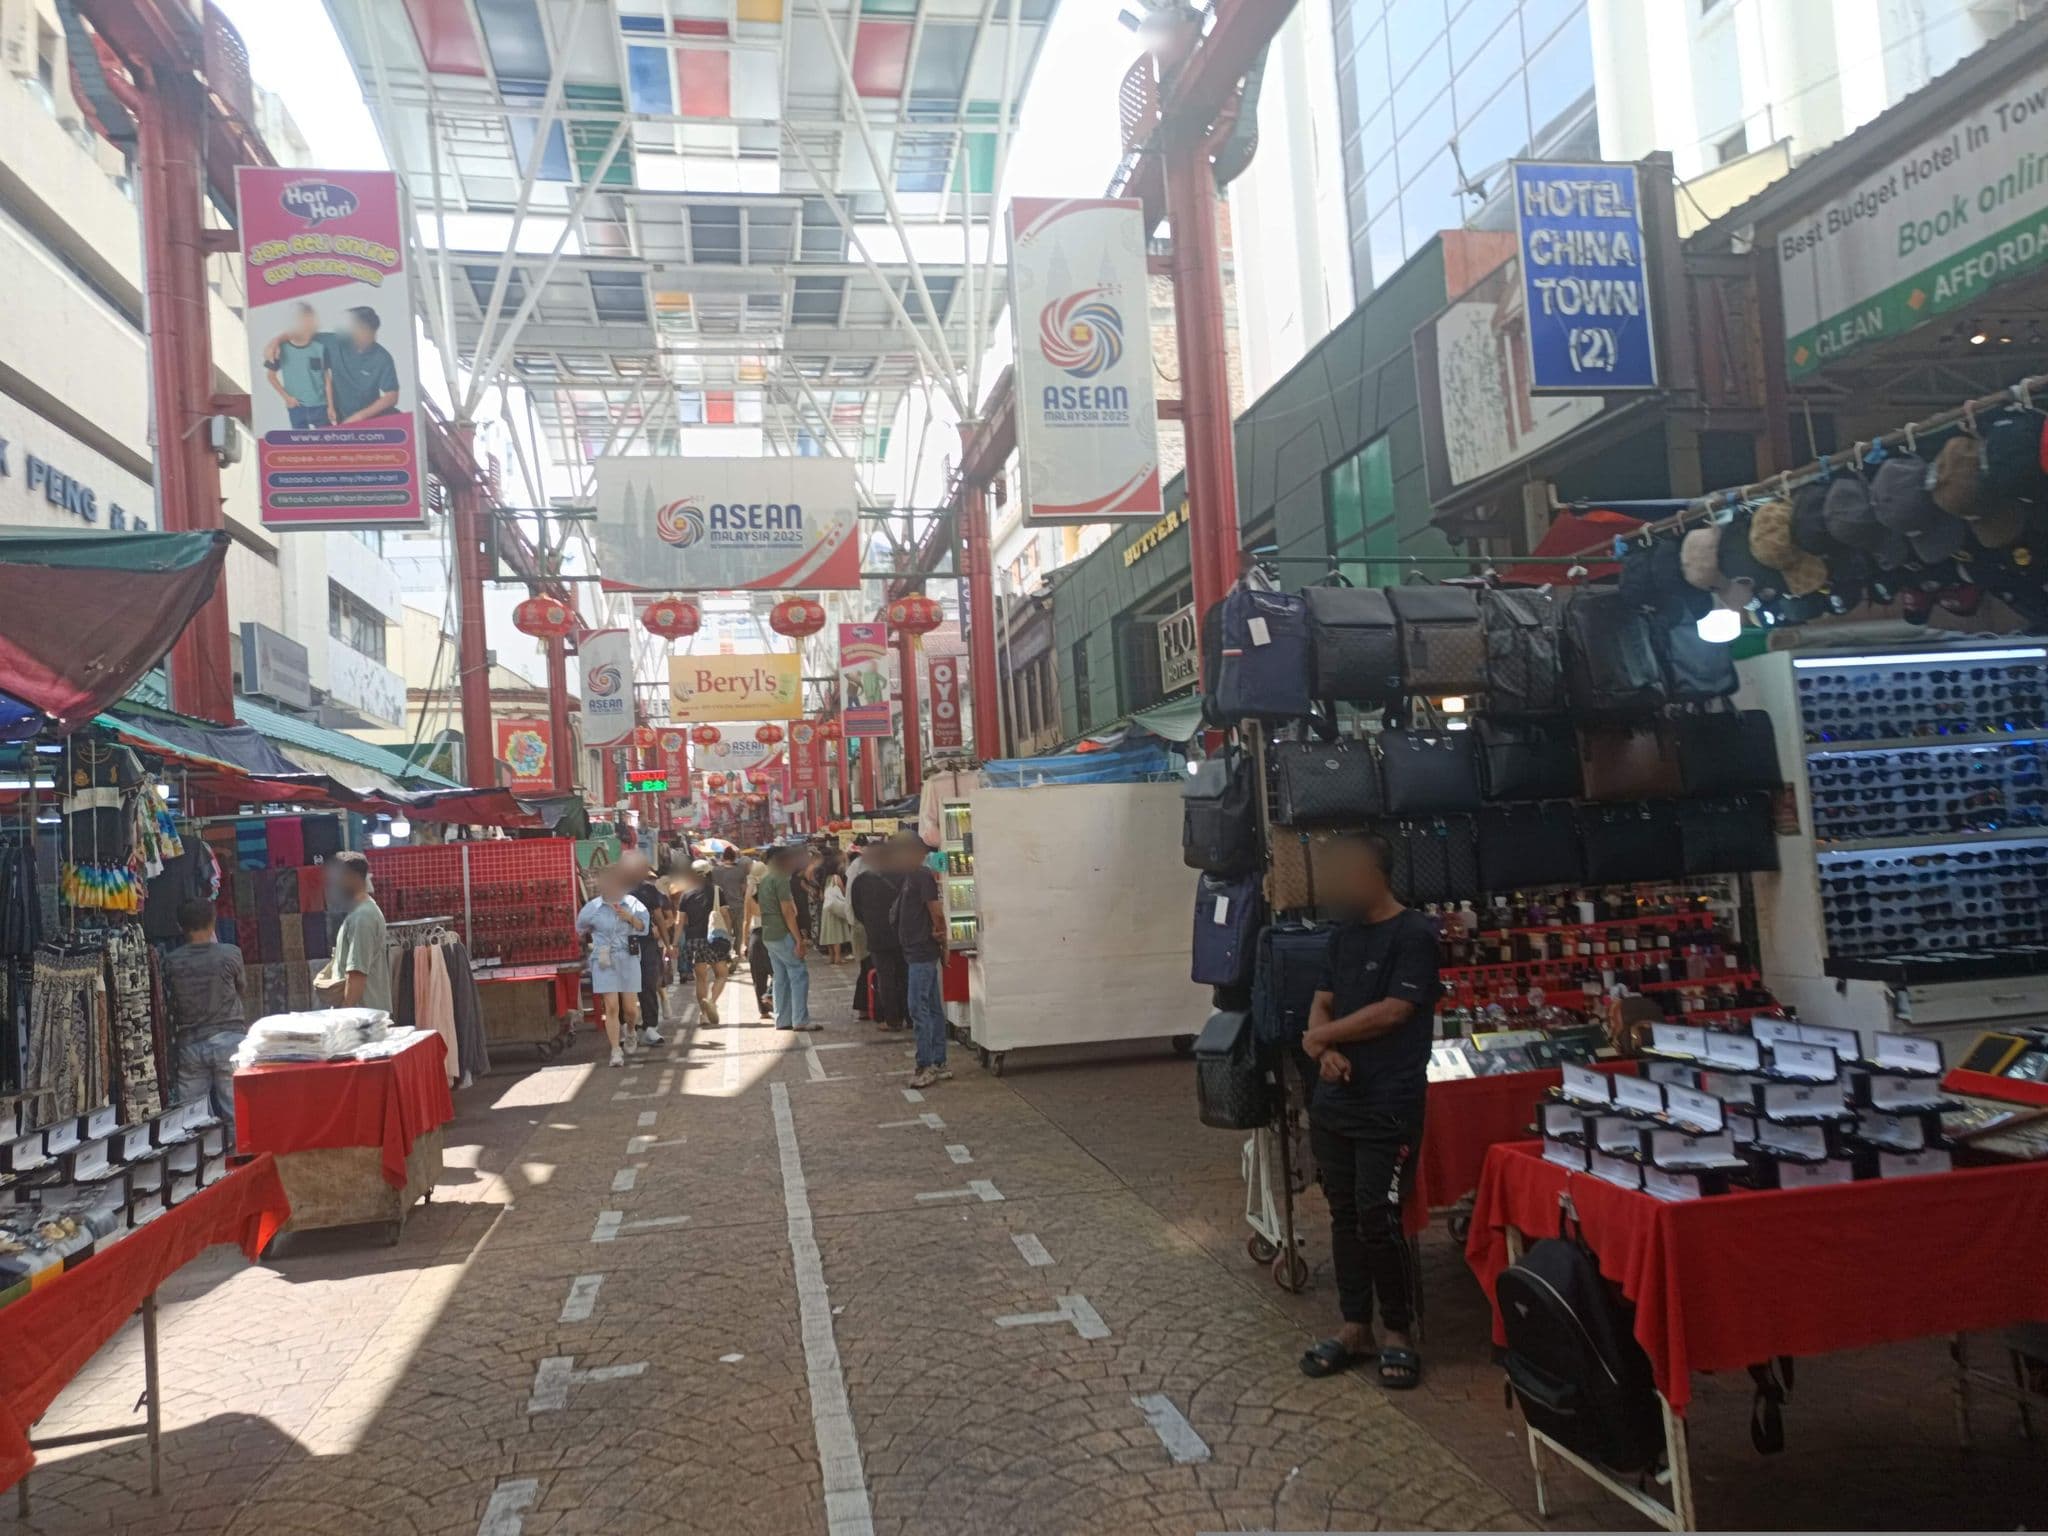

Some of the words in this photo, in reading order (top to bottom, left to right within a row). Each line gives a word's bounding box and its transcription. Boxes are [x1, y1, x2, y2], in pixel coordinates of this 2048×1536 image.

[285, 187, 329, 205] Hari
[310, 200, 351, 219] Hari
[1522, 180, 1634, 218] HOTEL
[1782, 221, 1823, 261] Best
[1827, 176, 1899, 236] Budget
[1902, 136, 1961, 190] Hotel
[1966, 124, 1990, 153] In
[1897, 195, 1970, 258] Book
[1529, 229, 1637, 267] CHINA
[1534, 277, 1640, 316] TOWN
[1568, 328, 1618, 372] (2)
[1815, 307, 1884, 358] CLEAN
[1044, 386, 1128, 409] ASEAN
[1044, 411, 1099, 421] MALAYSIA
[1102, 411, 1129, 421] 2025
[26, 454, 97, 523] PENG
[710, 504, 802, 529] ASEAN
[711, 531, 770, 542] MALAYSIA
[774, 531, 803, 542] 2025
[1123, 507, 1180, 568] BUTTER
[695, 669, 777, 699] Beryl's
[1168, 657, 1191, 681] HOTEL
[589, 699, 623, 709] ASEAN
[934, 665, 955, 718] OYO
